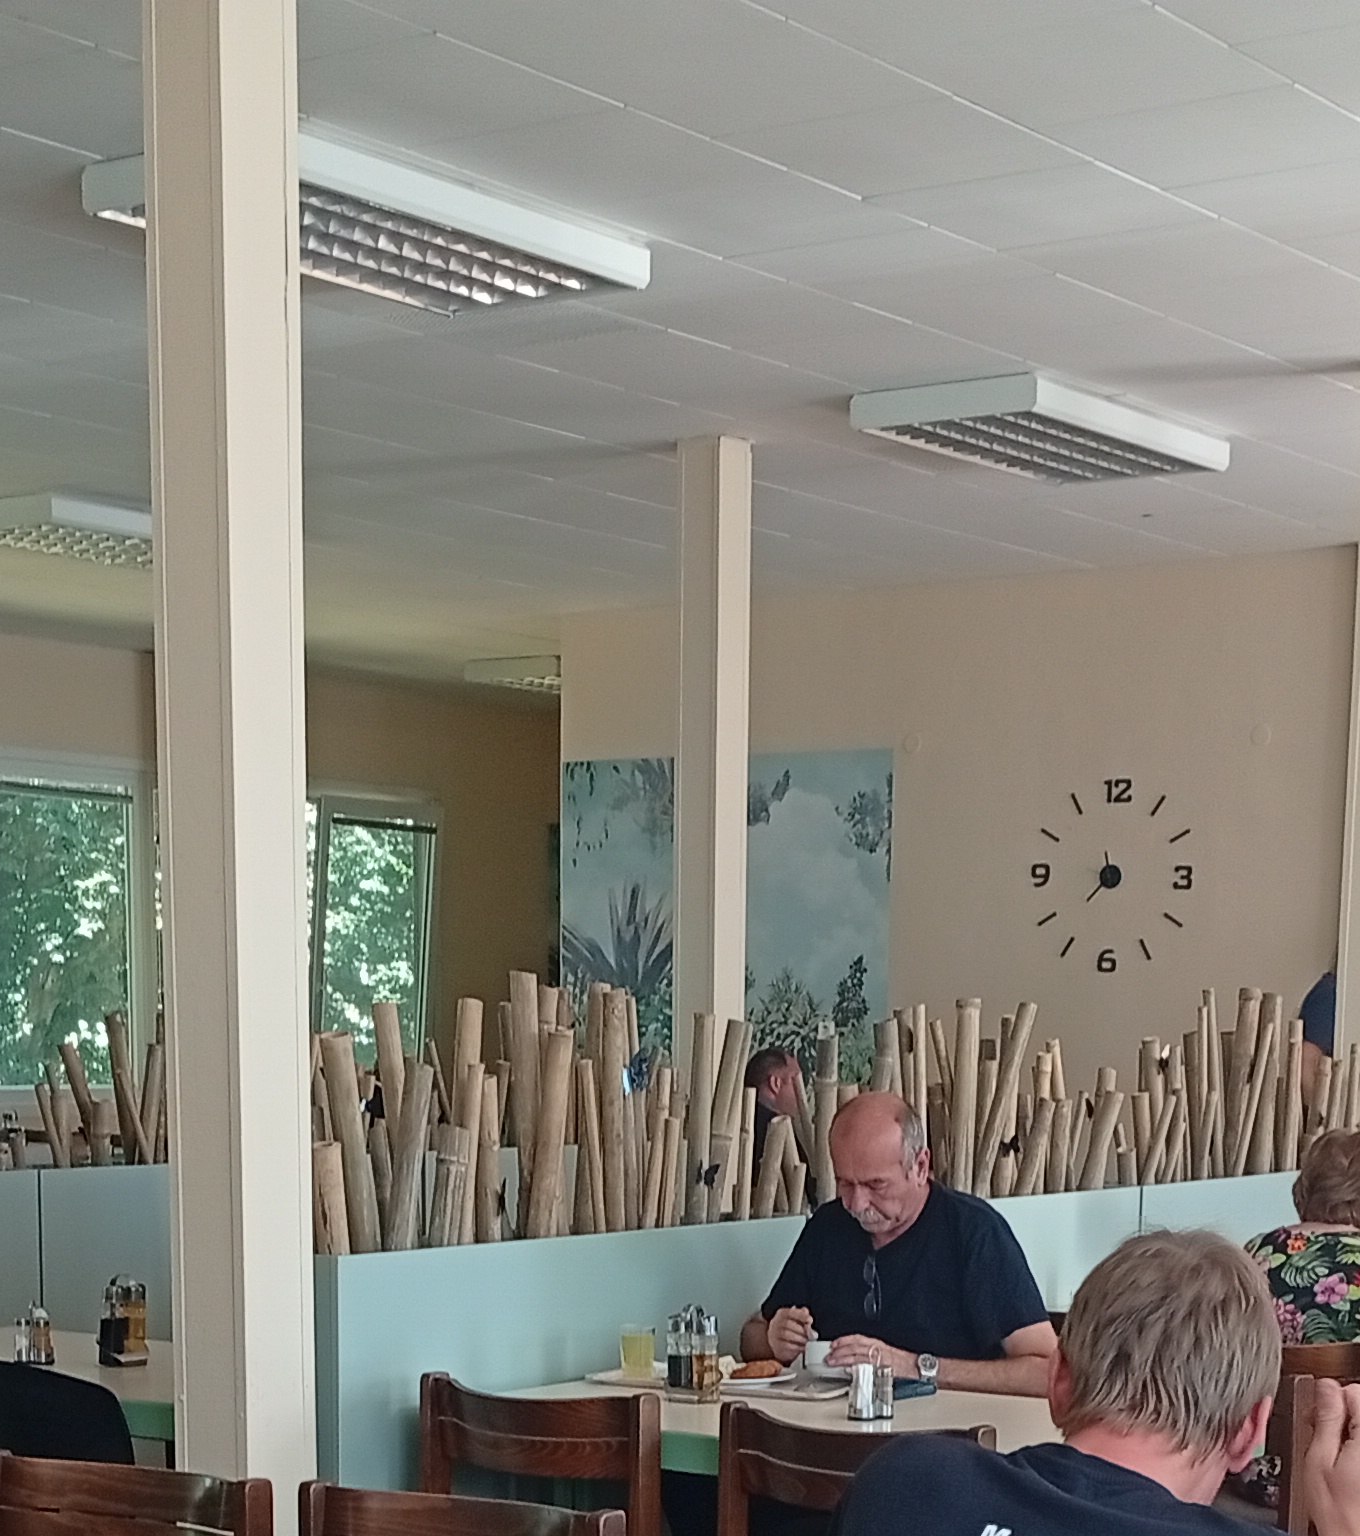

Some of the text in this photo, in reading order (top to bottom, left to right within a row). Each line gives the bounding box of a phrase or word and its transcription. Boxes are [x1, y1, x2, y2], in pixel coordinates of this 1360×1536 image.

[1104, 778, 1132, 804] 12
[1031, 863, 1051, 888] 9
[1172, 865, 1193, 890] 3
[1096, 949, 1117, 973] 6
